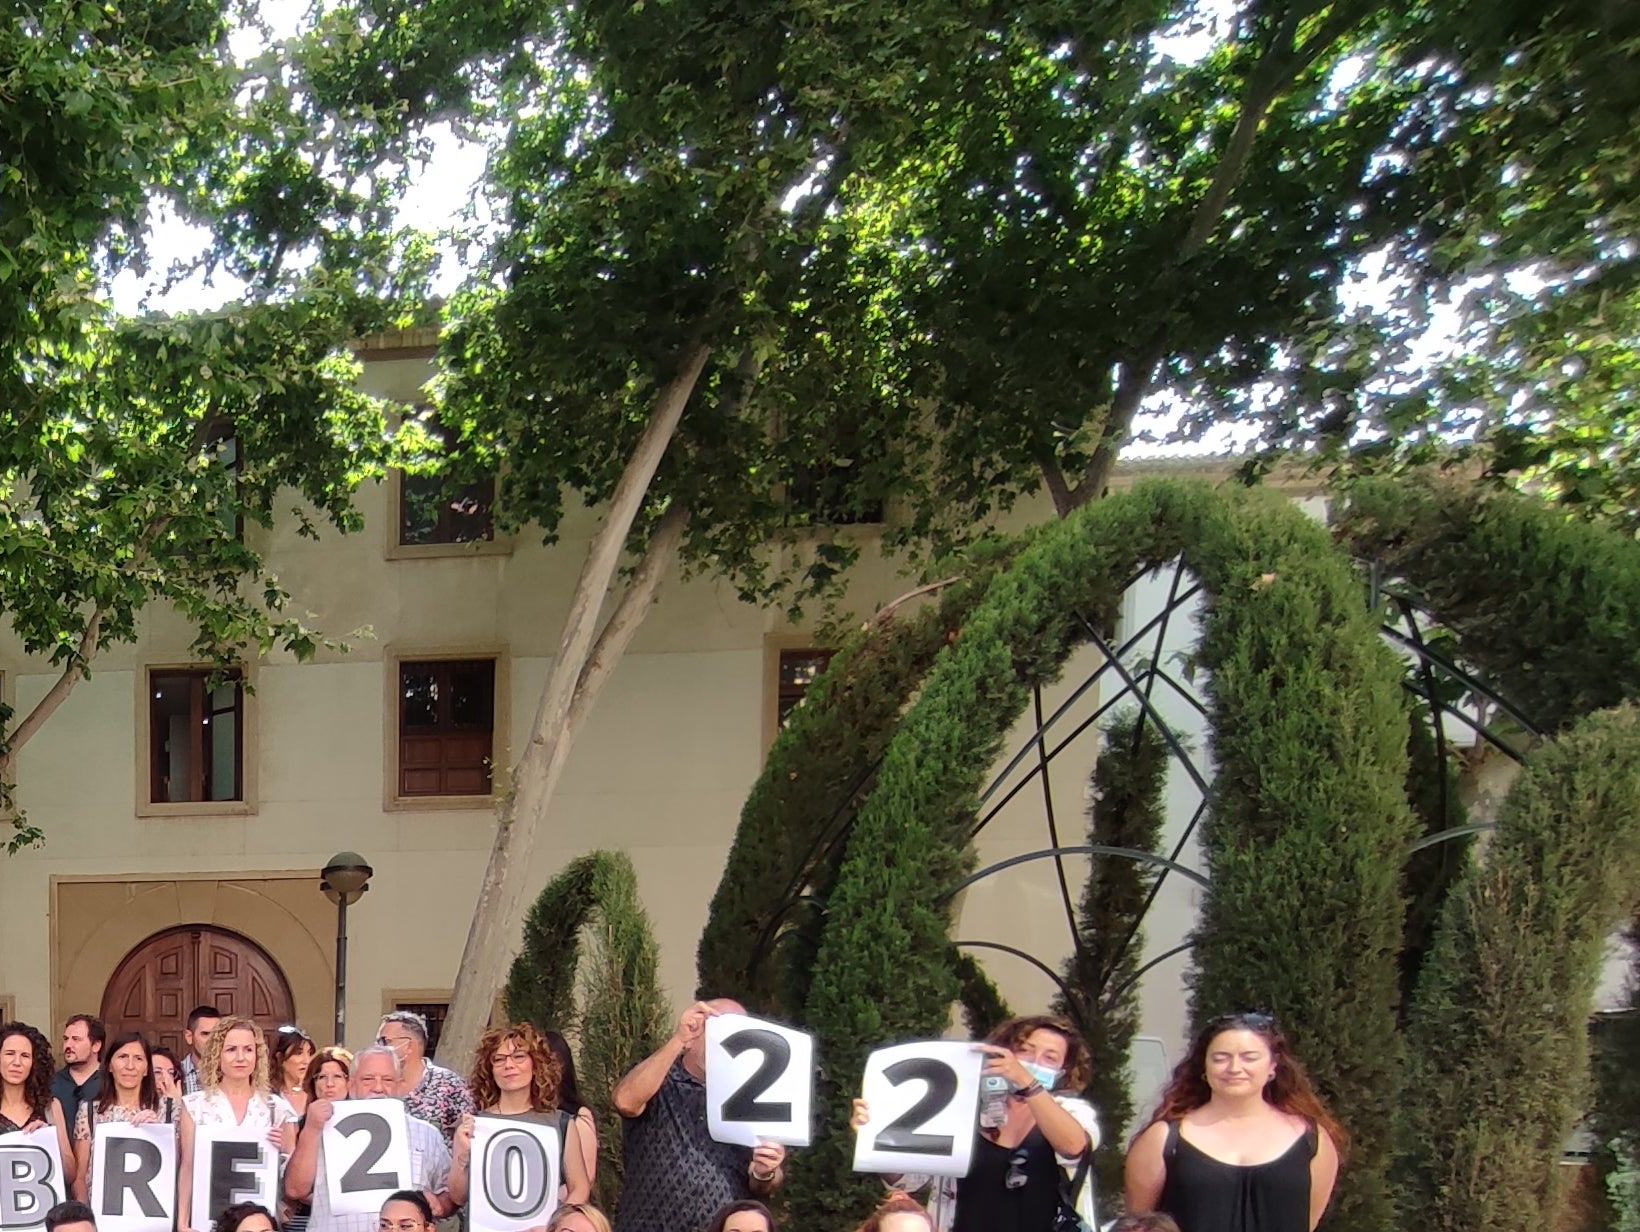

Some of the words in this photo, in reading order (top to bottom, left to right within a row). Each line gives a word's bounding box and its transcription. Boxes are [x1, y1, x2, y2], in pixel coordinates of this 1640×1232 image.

[721, 1029, 792, 1123] 2
[873, 1057, 958, 1156] 2
[102, 1137, 169, 1218] R
[339, 1113, 399, 1194] 2
